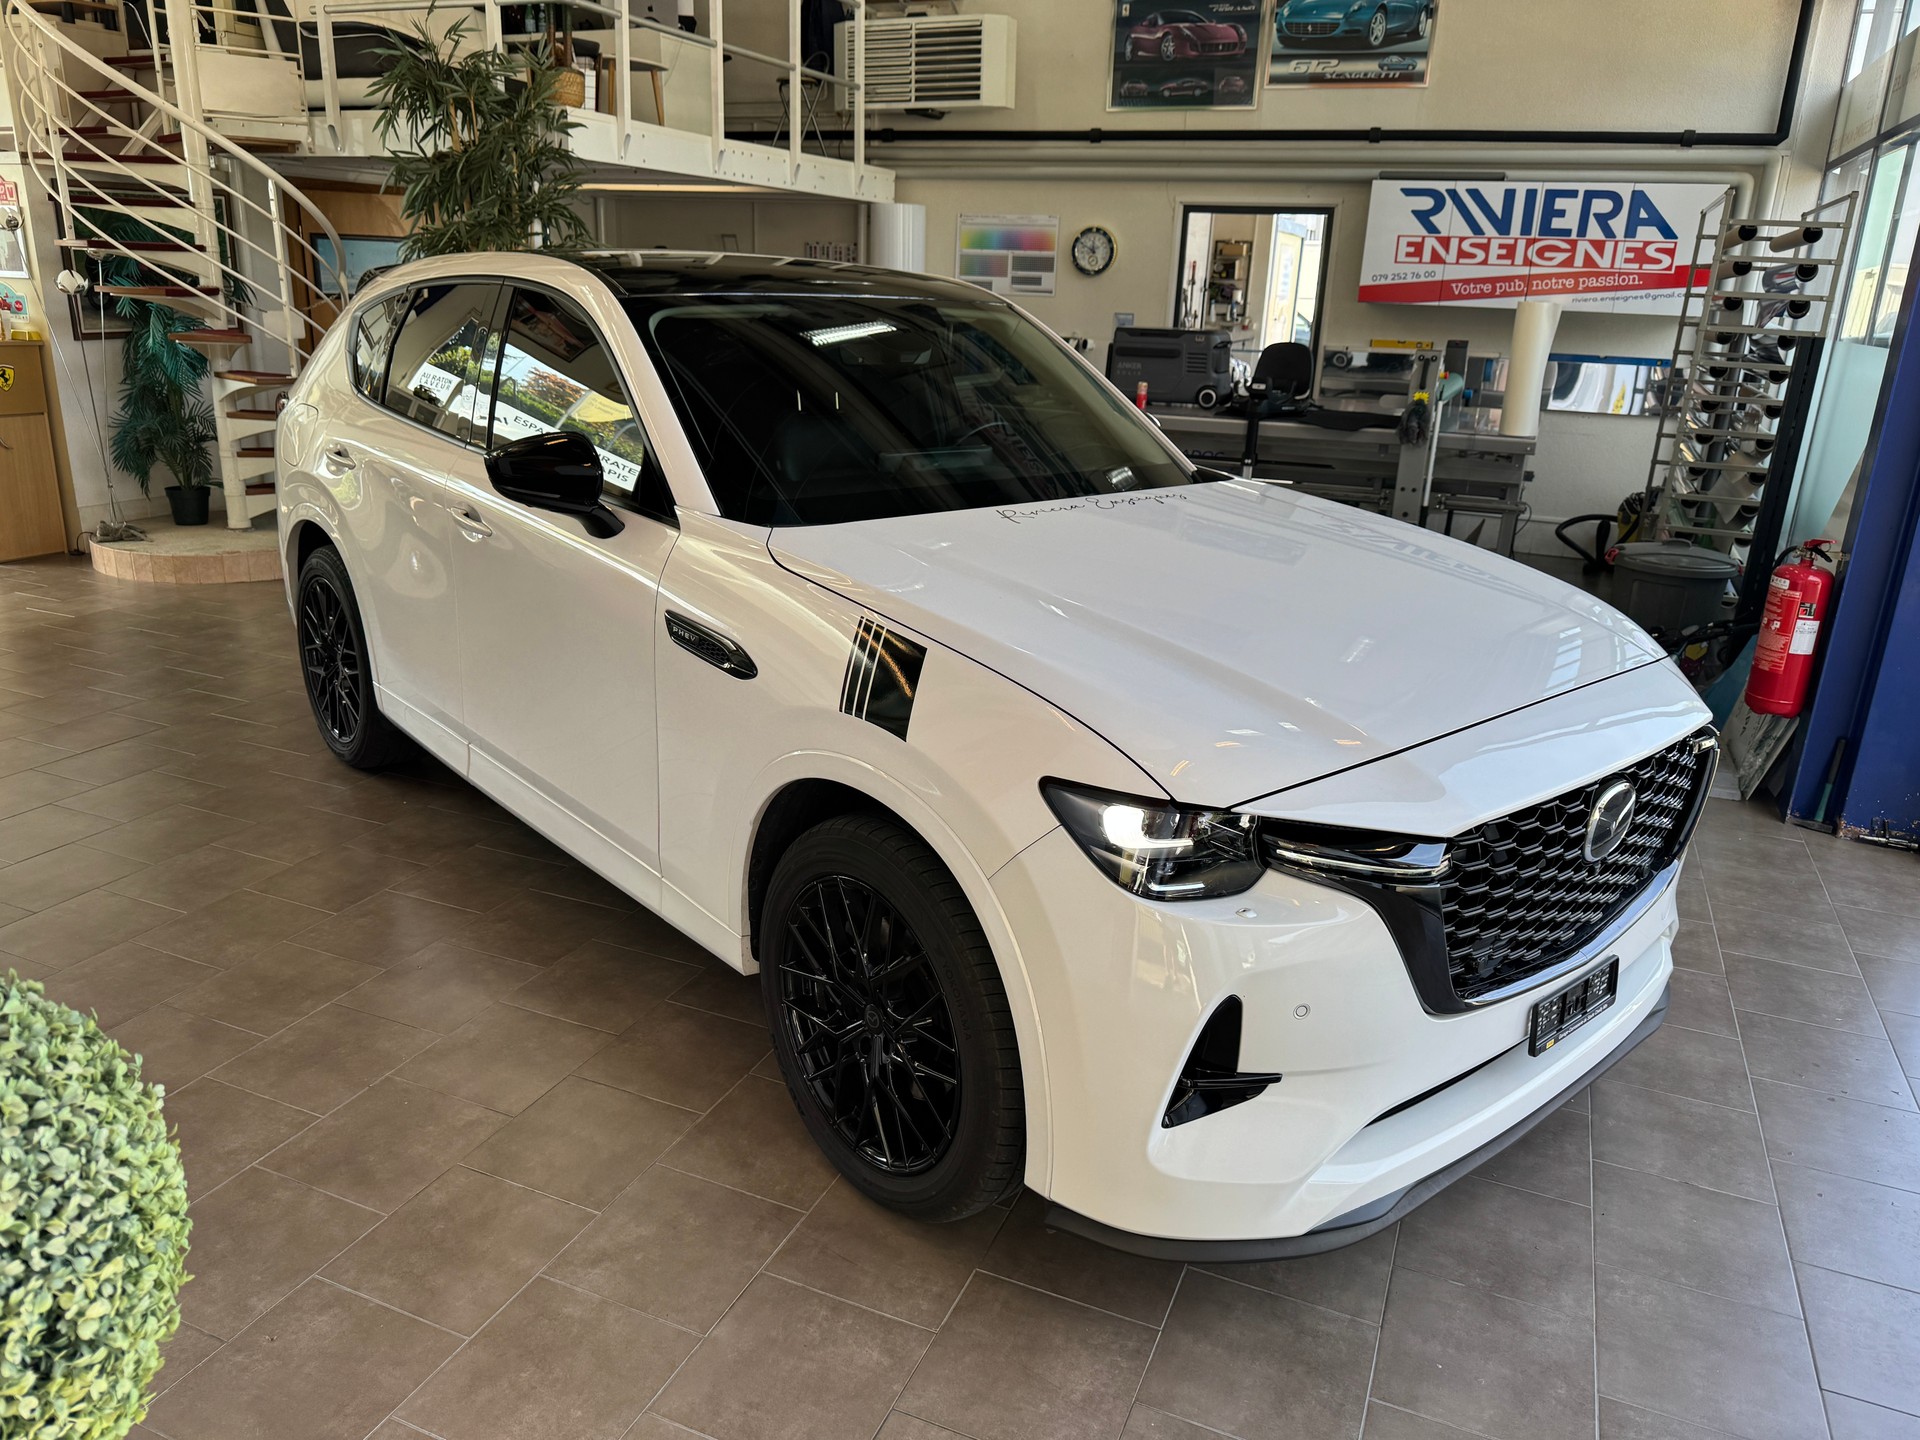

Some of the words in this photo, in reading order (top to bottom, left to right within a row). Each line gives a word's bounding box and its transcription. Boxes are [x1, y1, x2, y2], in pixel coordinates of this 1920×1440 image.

[1400, 188, 1678, 239] RIVIERA
[1397, 236, 1673, 270] ENSEIGNES
[1372, 273, 1388, 282] 079
[1391, 272, 1407, 281] 252
[1411, 271, 1421, 280] 76
[1424, 270, 1436, 279] 00
[1451, 280, 1492, 295] Votre
[1532, 275, 1575, 290] notre
[1578, 272, 1643, 290] passion.
[513, 415, 545, 435] ESPA
[599, 453, 639, 476] RATE
[673, 626, 696, 641] PHEV
